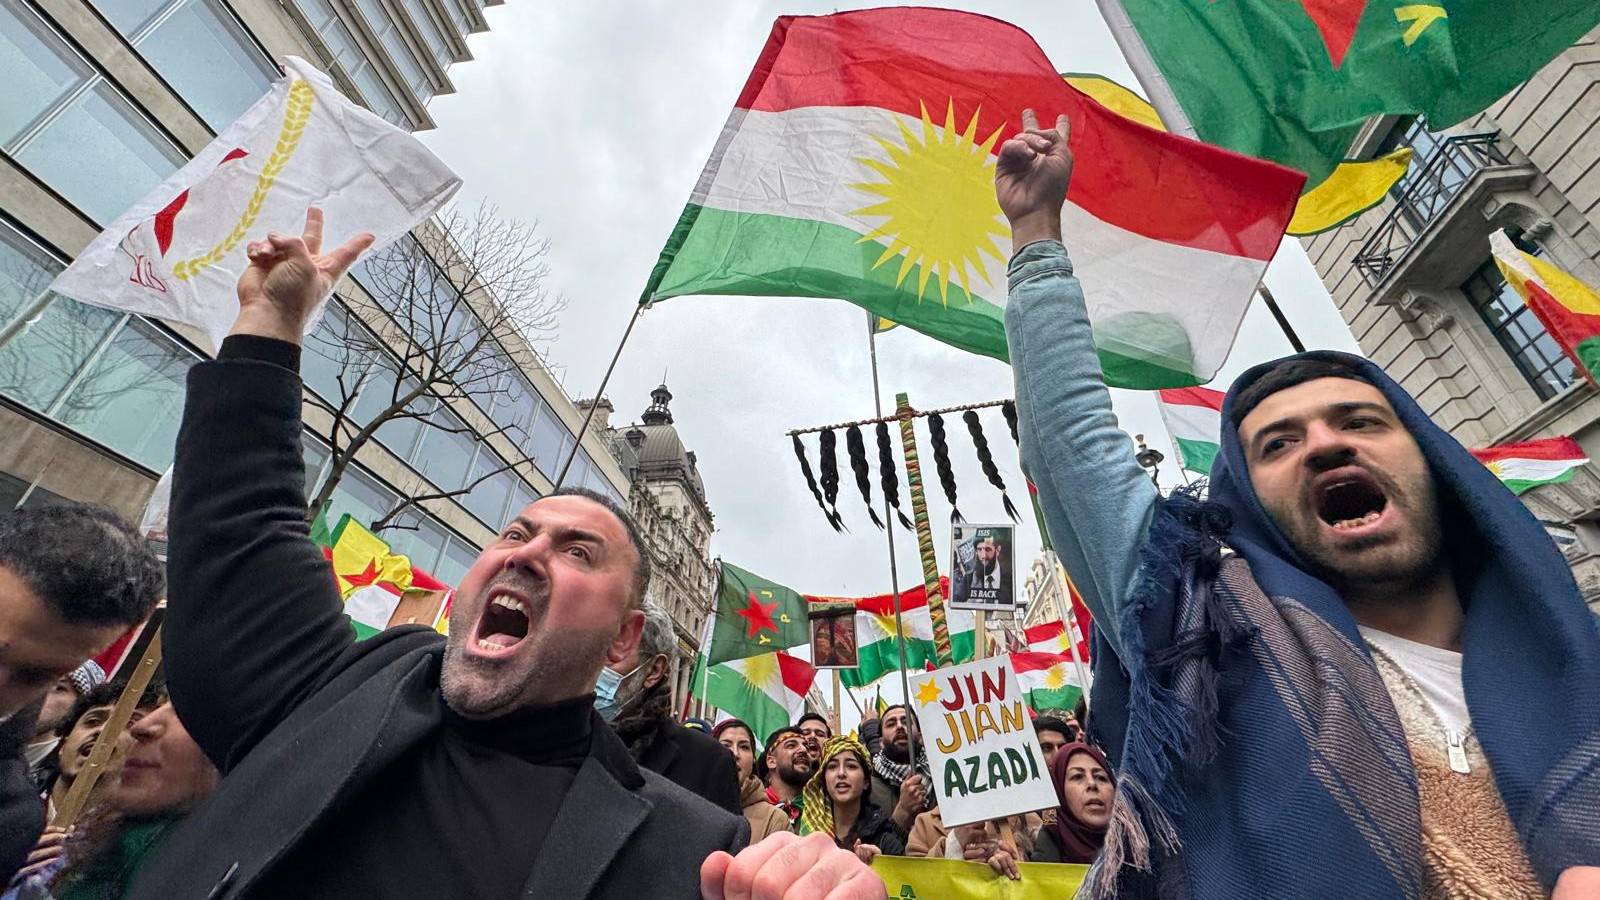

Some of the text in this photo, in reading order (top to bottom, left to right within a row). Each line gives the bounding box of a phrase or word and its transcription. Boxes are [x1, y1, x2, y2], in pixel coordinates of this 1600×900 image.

[977, 529, 990, 537] ISIS
[970, 589, 997, 598] IS BACK
[940, 666, 1006, 712] JIN
[936, 700, 1025, 754] JIAN
[944, 742, 1040, 798] AZADI
